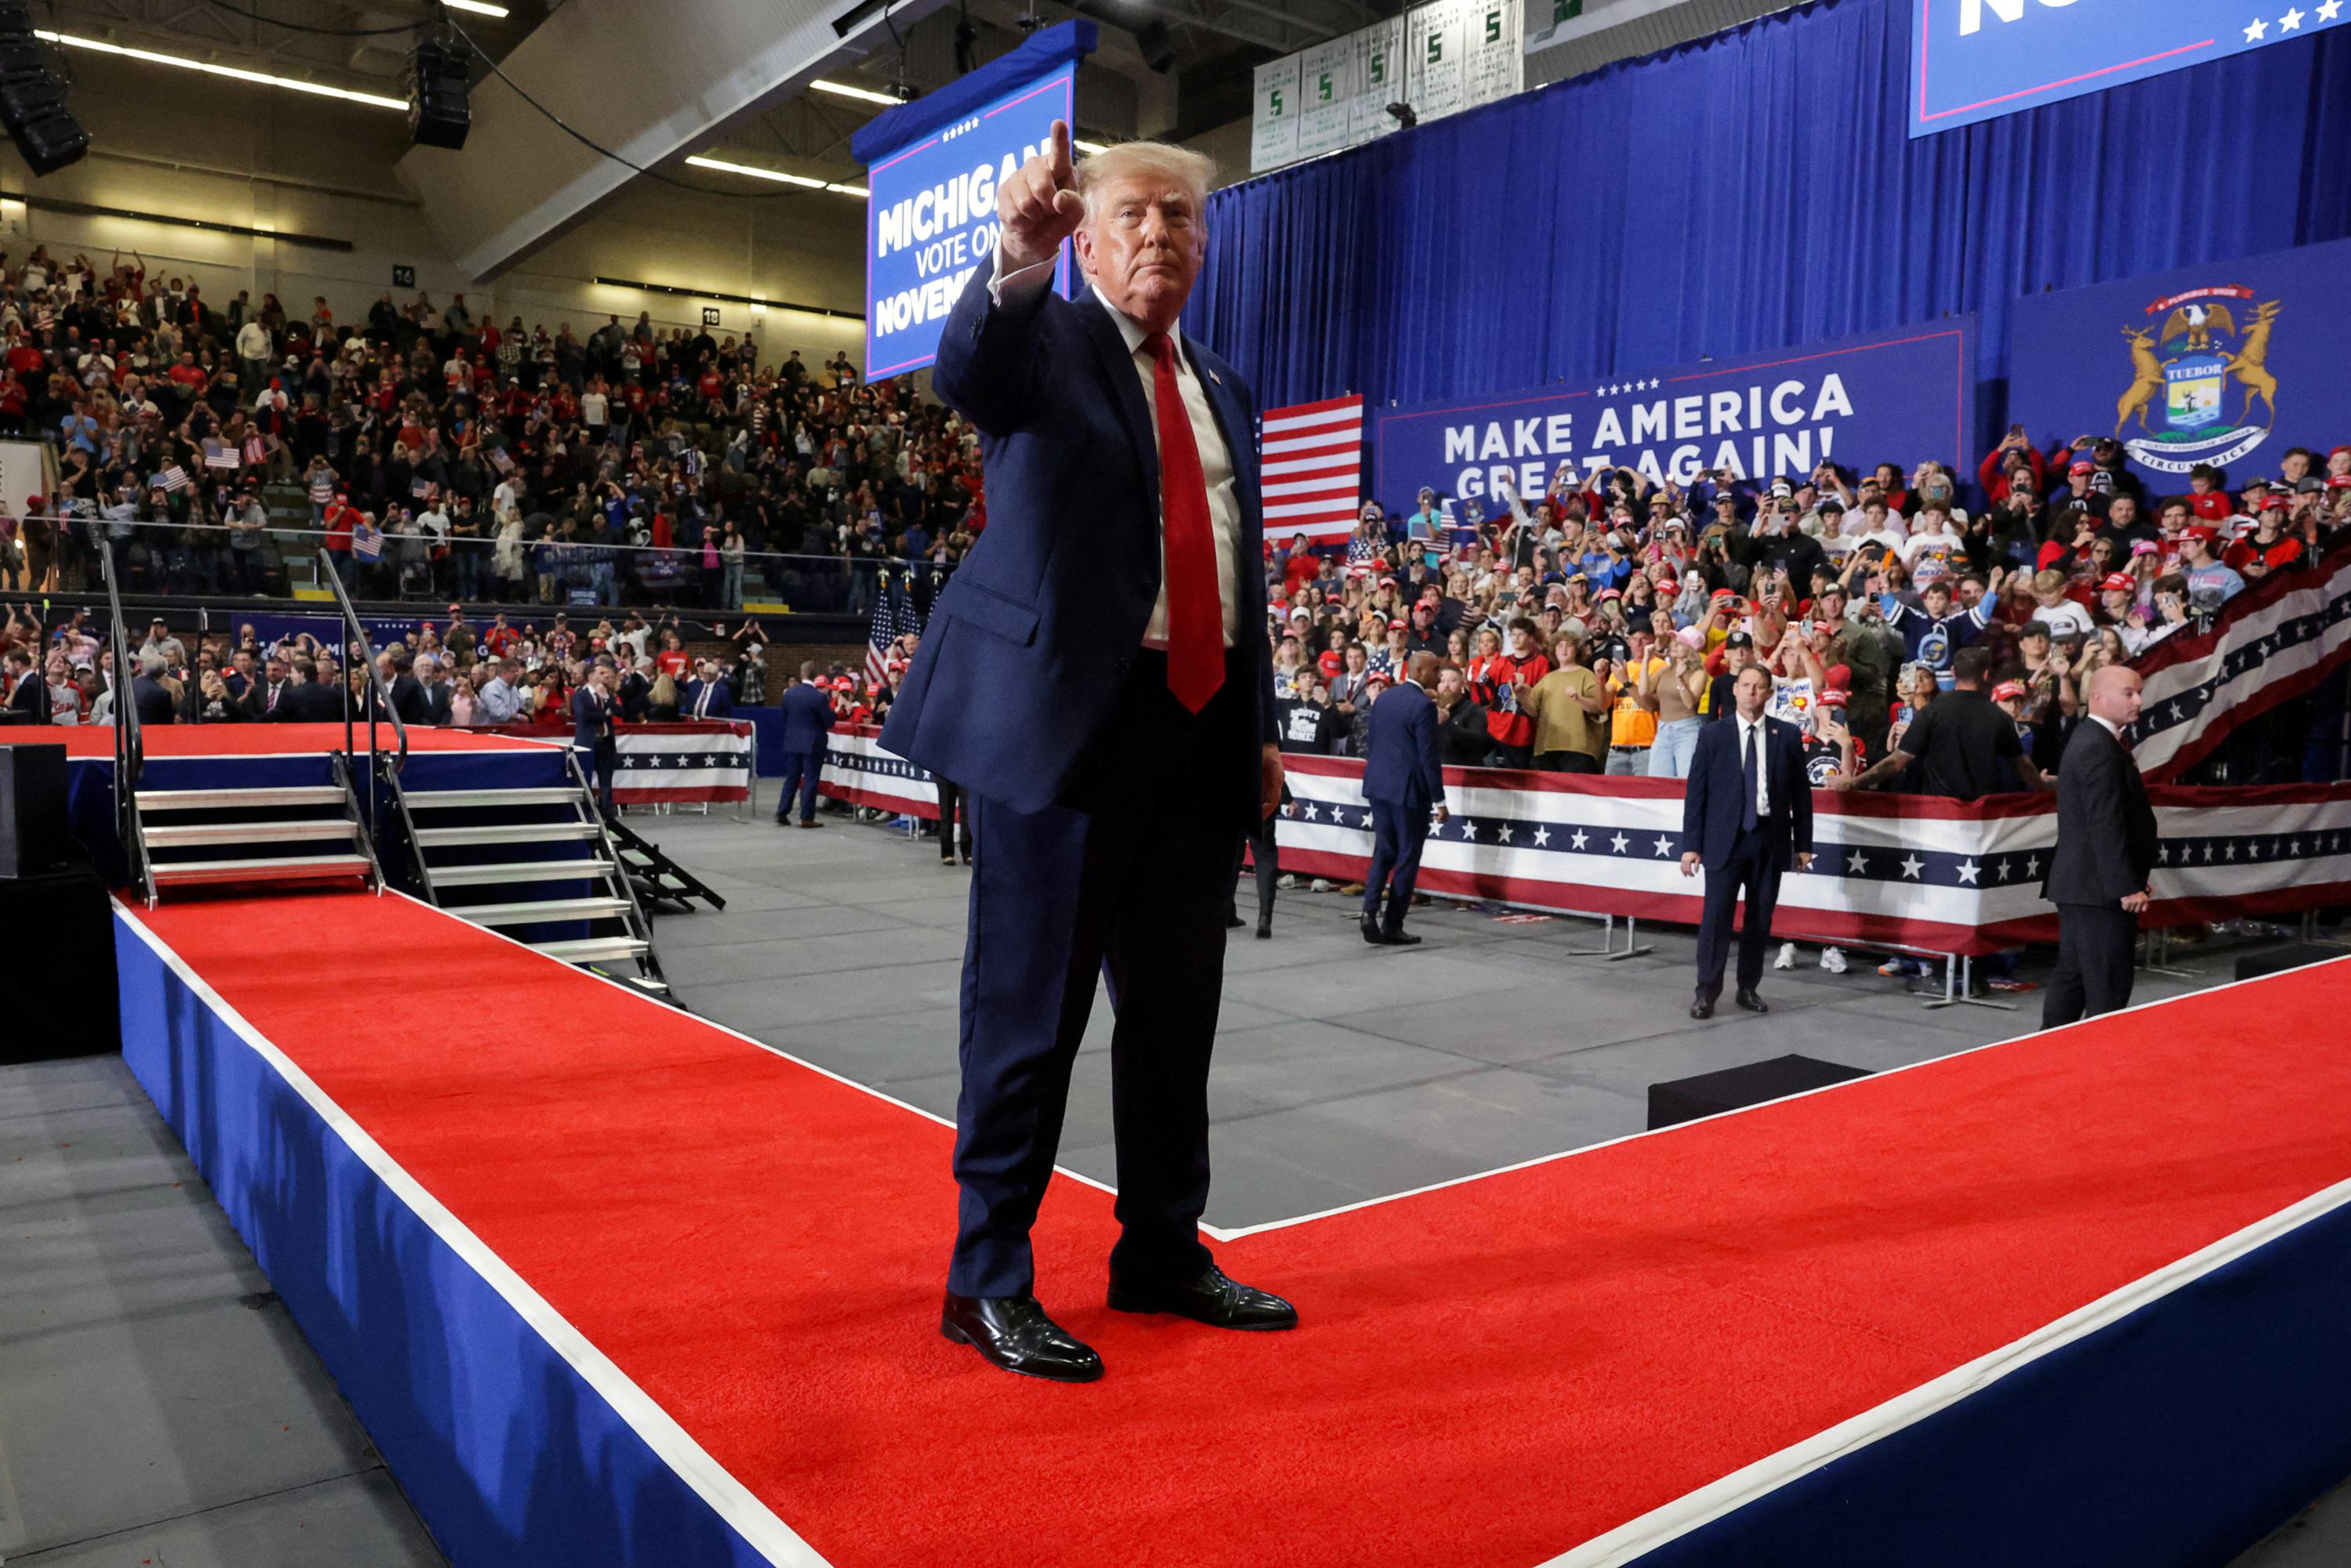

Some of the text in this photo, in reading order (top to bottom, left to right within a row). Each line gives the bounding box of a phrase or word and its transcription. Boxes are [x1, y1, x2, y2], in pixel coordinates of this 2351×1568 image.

[396, 270, 412, 284] 16
[915, 232, 967, 278] VOTE
[704, 310, 719, 324] 18
[876, 266, 978, 337] NOVEM
[2168, 364, 2222, 380] TUEBOR
[1444, 373, 1853, 463] MAKE AMERICA
[1457, 425, 1834, 502] GREAT AGAIN!
